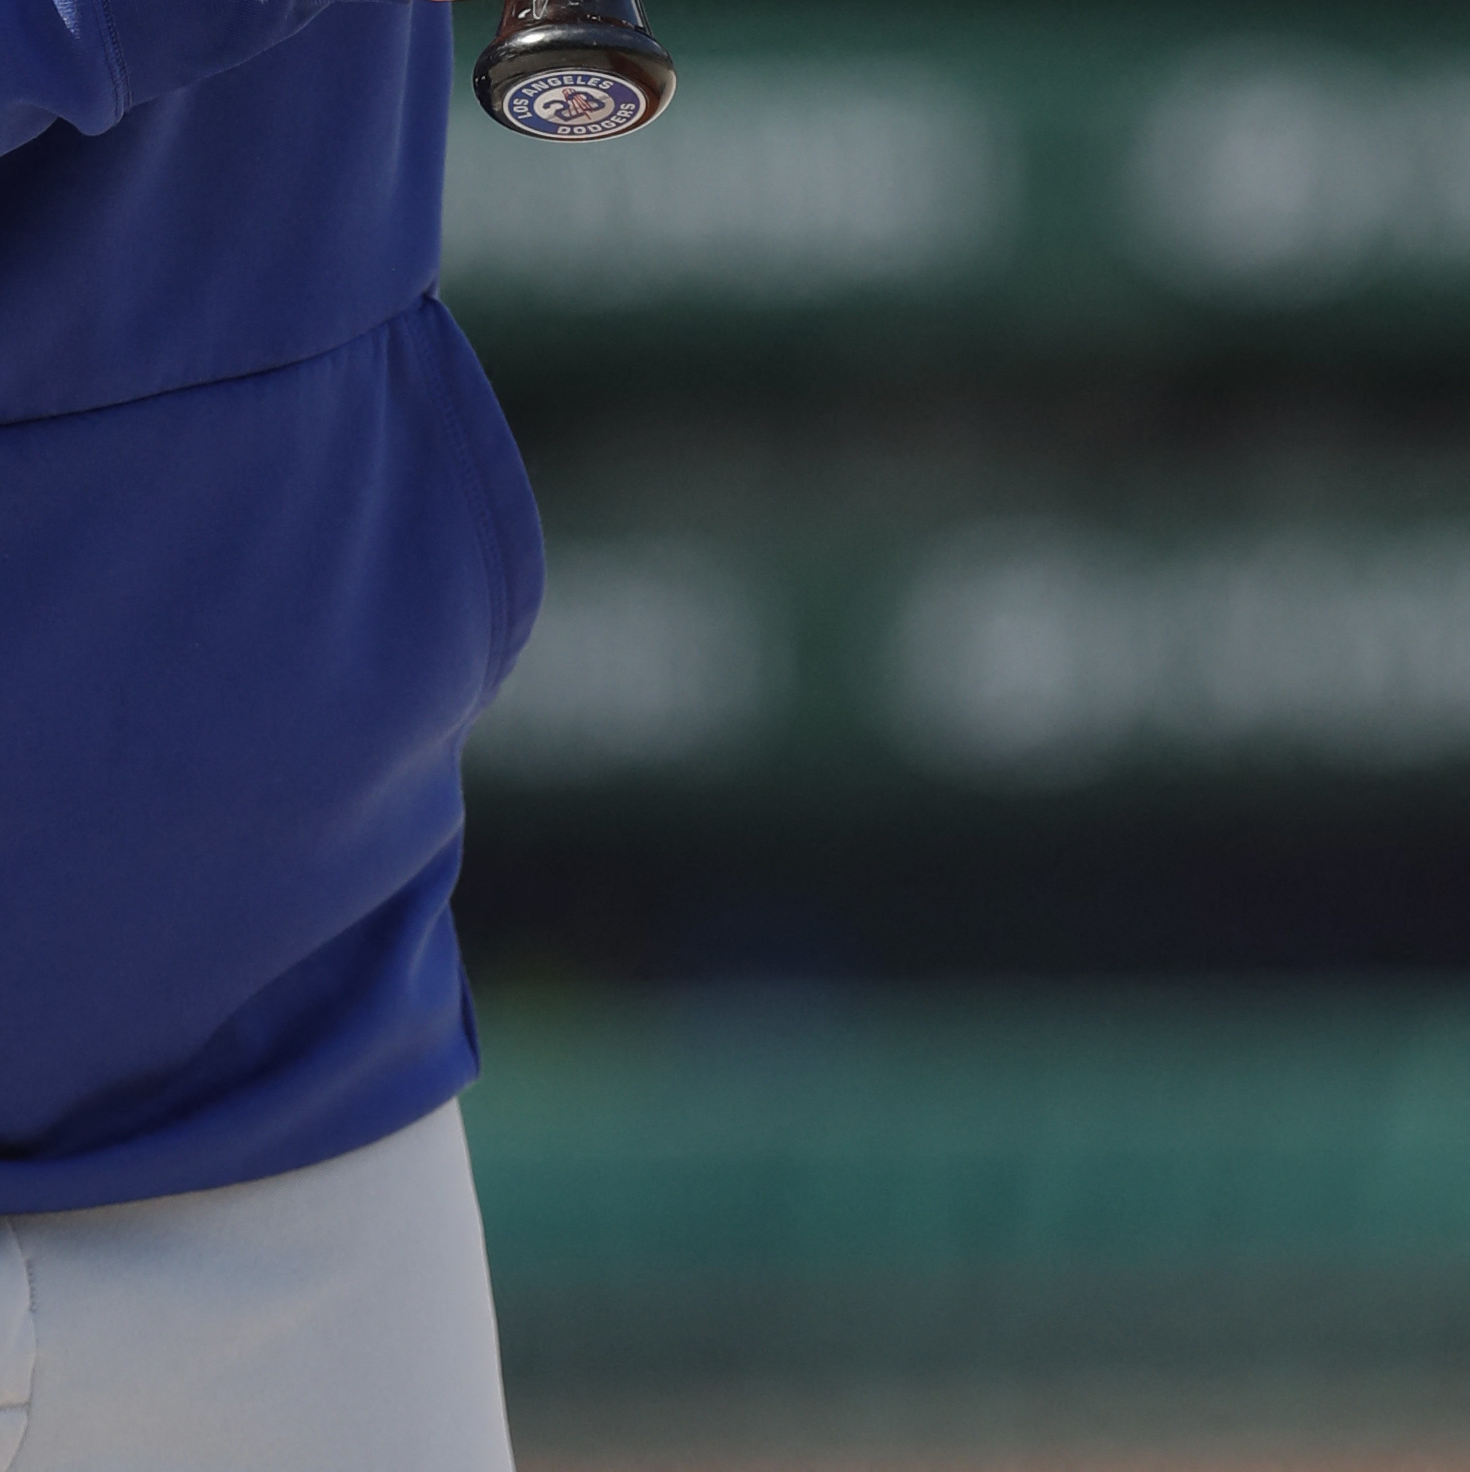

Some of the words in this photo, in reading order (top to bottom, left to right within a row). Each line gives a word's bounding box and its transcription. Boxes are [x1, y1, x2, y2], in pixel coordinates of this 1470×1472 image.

[521, 75, 614, 97] ANGELES
[512, 97, 533, 119] LOS
[556, 102, 636, 135] DODGERS
